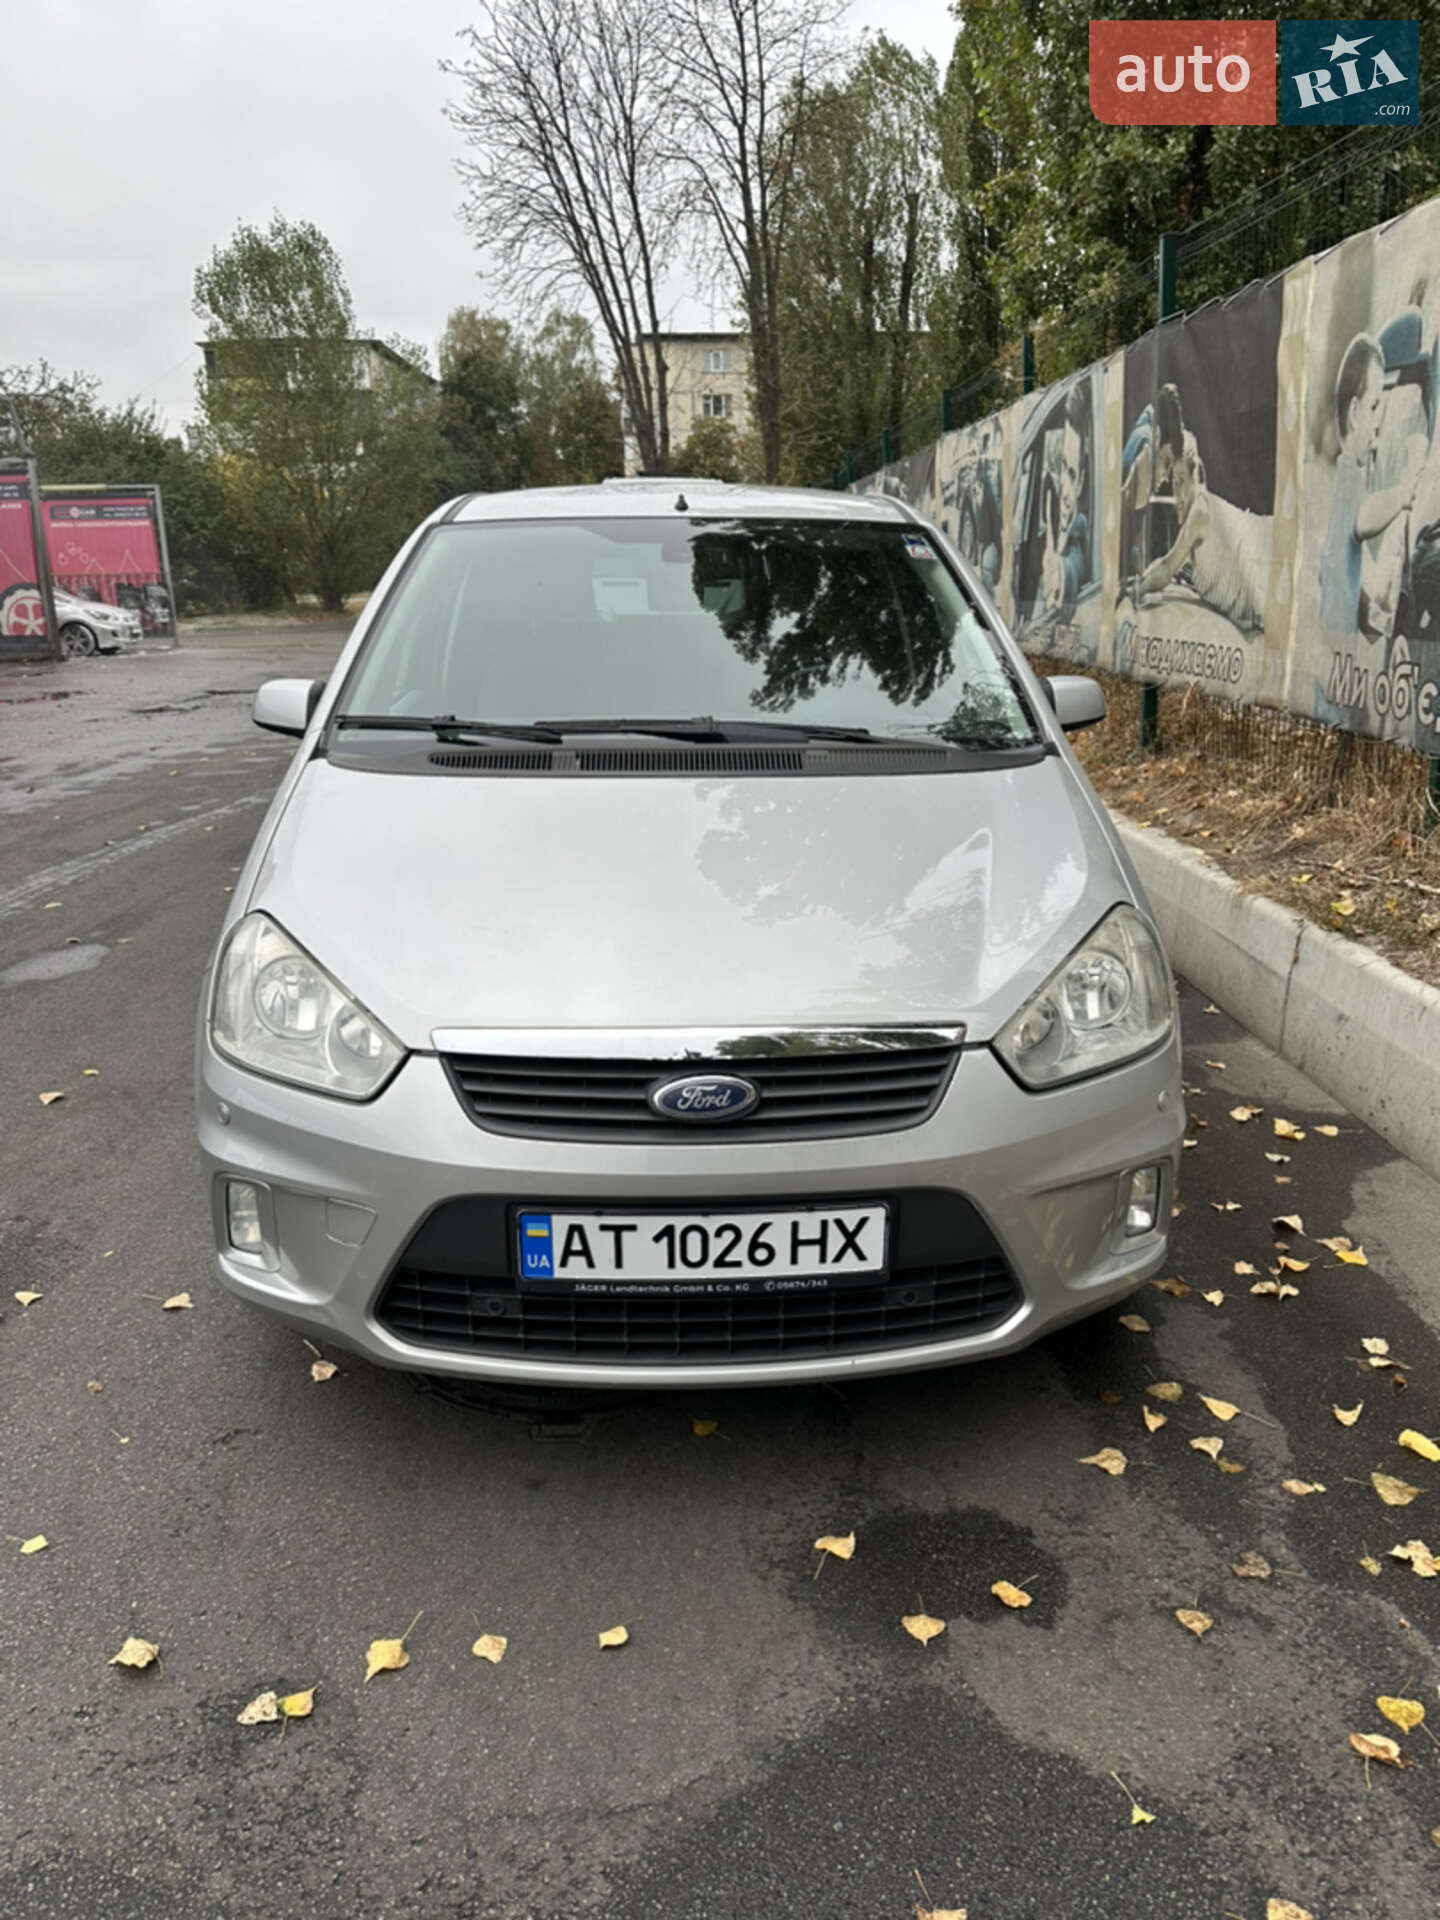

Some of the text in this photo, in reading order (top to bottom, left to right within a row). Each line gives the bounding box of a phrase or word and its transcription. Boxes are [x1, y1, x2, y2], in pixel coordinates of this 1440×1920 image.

[1327, 651, 1440, 734] Ми об'є
[677, 1085, 731, 1109] Ford
[559, 1216, 870, 1269] AT 1026 HX
[526, 1254, 551, 1268] UA
[609, 1284, 669, 1293] Landtechnik
[673, 1284, 704, 1293] GmbH
[707, 1284, 714, 1293] &
[735, 1282, 750, 1291] KG
